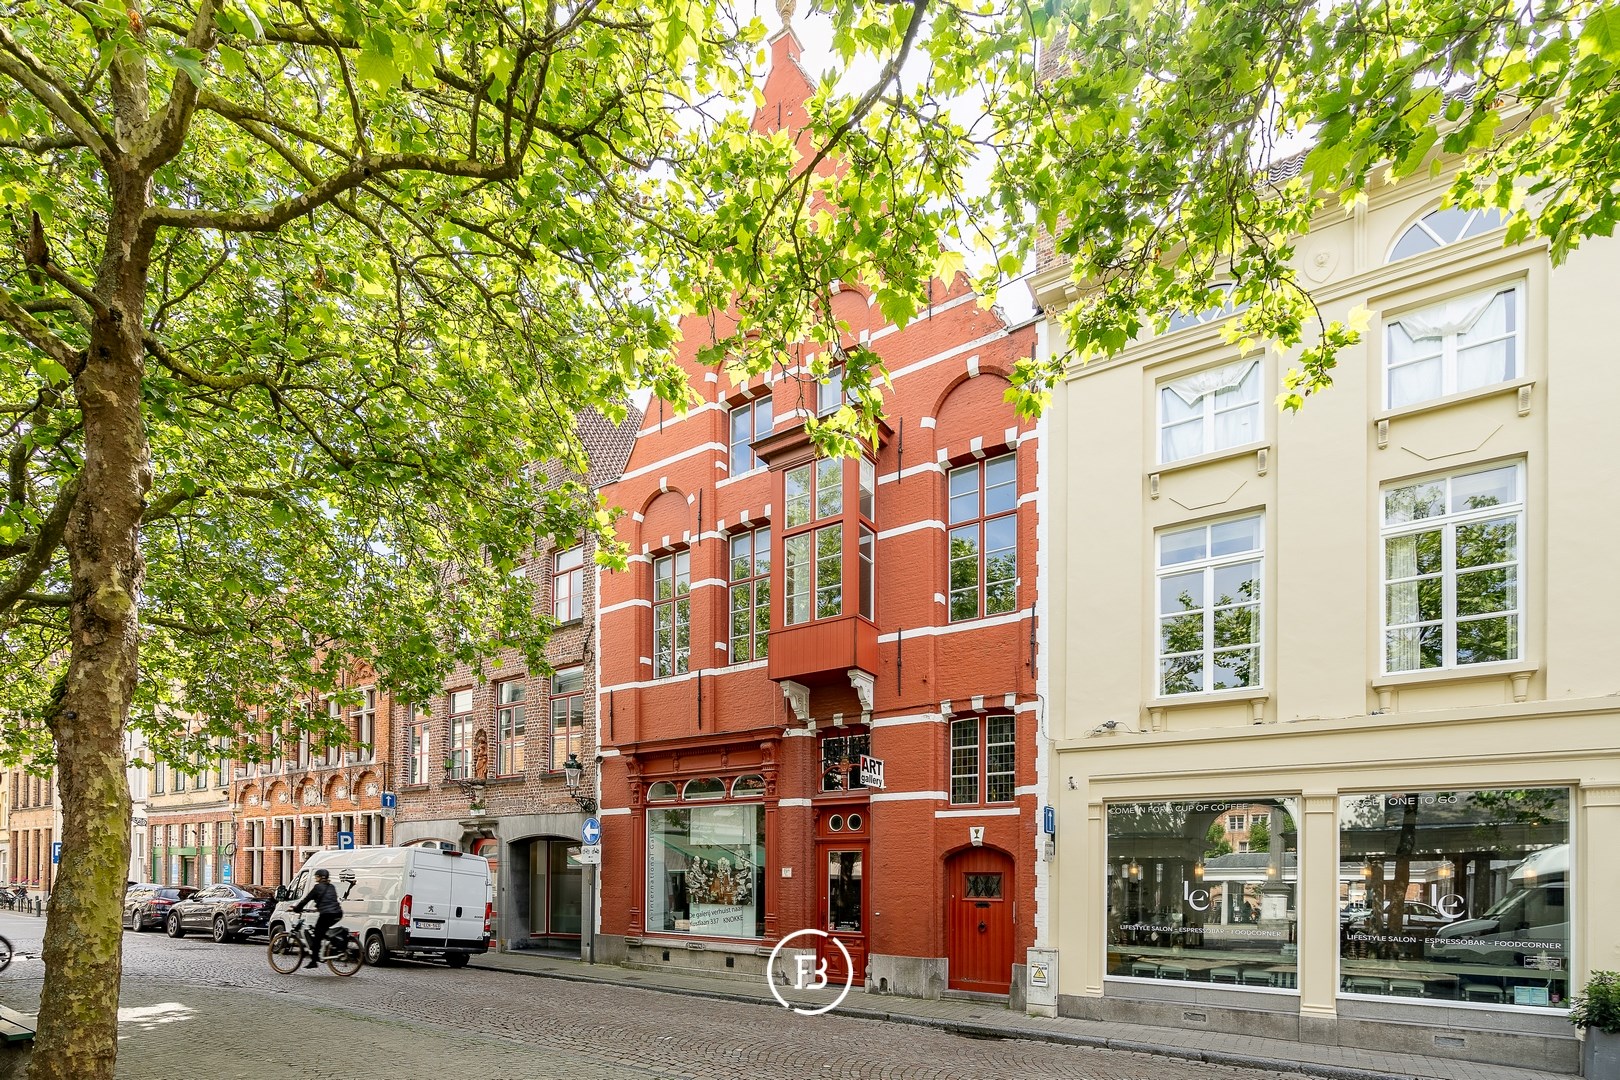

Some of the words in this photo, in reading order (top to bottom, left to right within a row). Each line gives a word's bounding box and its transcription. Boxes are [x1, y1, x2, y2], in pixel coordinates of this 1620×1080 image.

[861, 756, 882, 776] ART
[861, 774, 882, 787] gallery
[1388, 797, 1416, 806] ONE
[1420, 797, 1435, 805] TO
[1438, 795, 1458, 804] GO
[1109, 807, 1135, 815] COME
[1148, 806, 1165, 814] FOR
[1175, 804, 1194, 813] CUP
[1195, 804, 1209, 812] OF
[1210, 803, 1248, 812] COFFEE
[340, 835, 352, 850] P
[696, 910, 711, 919] galerij
[711, 907, 731, 916] verhuist
[710, 917, 720, 925] 337
[722, 914, 743, 924] KNOKKE
[1120, 924, 1150, 932] LIFESTYLE
[1178, 926, 1225, 935] ESPRESSOBAR
[1346, 934, 1387, 942] LIFESTYLE
[1424, 937, 1486, 946] ESPRESSOBAR
[1494, 940, 1562, 949] FOODCORNER
